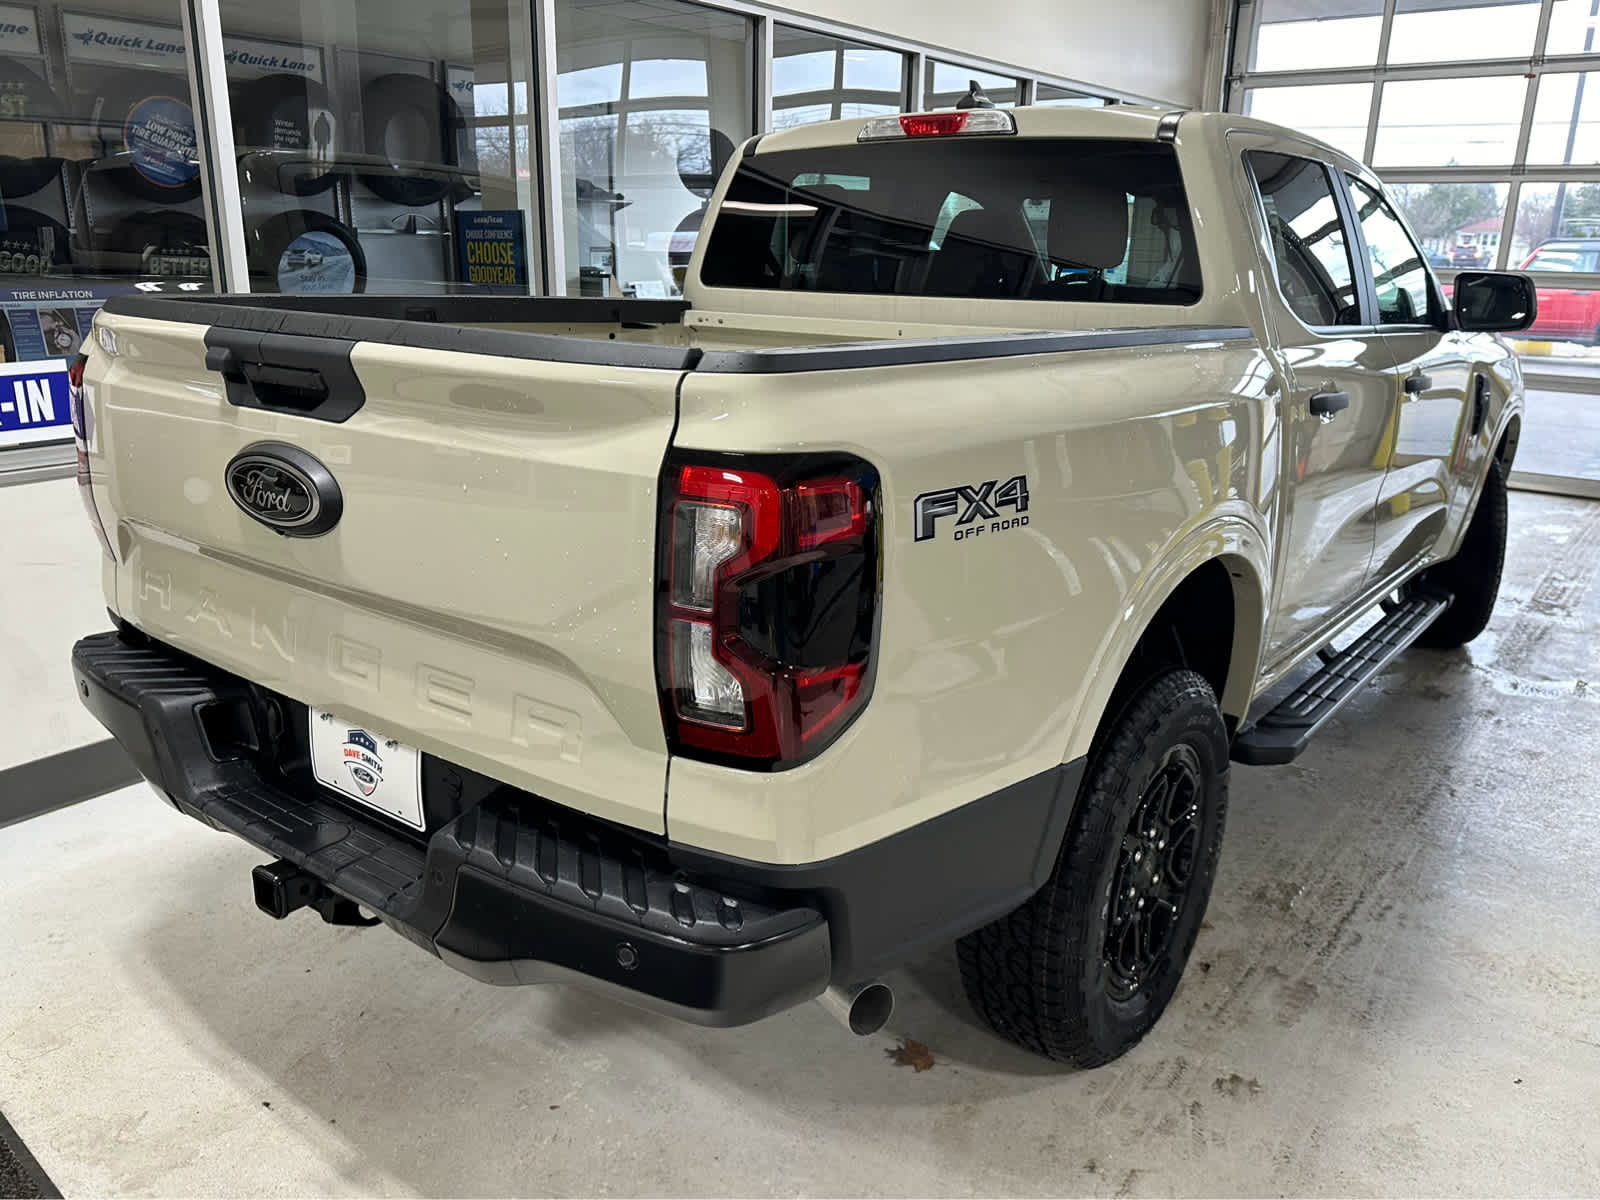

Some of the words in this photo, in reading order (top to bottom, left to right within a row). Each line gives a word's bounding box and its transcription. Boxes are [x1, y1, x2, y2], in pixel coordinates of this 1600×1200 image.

[95, 31, 143, 48] Quick
[145, 40, 186, 54] Lane
[238, 51, 278, 68] Quick
[131, 125, 152, 140] TIRE
[145, 119, 168, 134] LOW
[166, 128, 193, 146] PRICE
[467, 241, 515, 265] CHOOSE
[468, 265, 517, 285] GOODYEAR
[10, 291, 40, 300] TIRE
[39, 290, 94, 300] INFLATION
[242, 469, 292, 513] Ford
[913, 474, 1030, 543] FX4
[953, 524, 985, 541] OFF
[991, 515, 1030, 533] ROAD
[138, 568, 585, 767] RANGER
[343, 748, 361, 760] DAVE
[361, 752, 383, 774] SMITH
